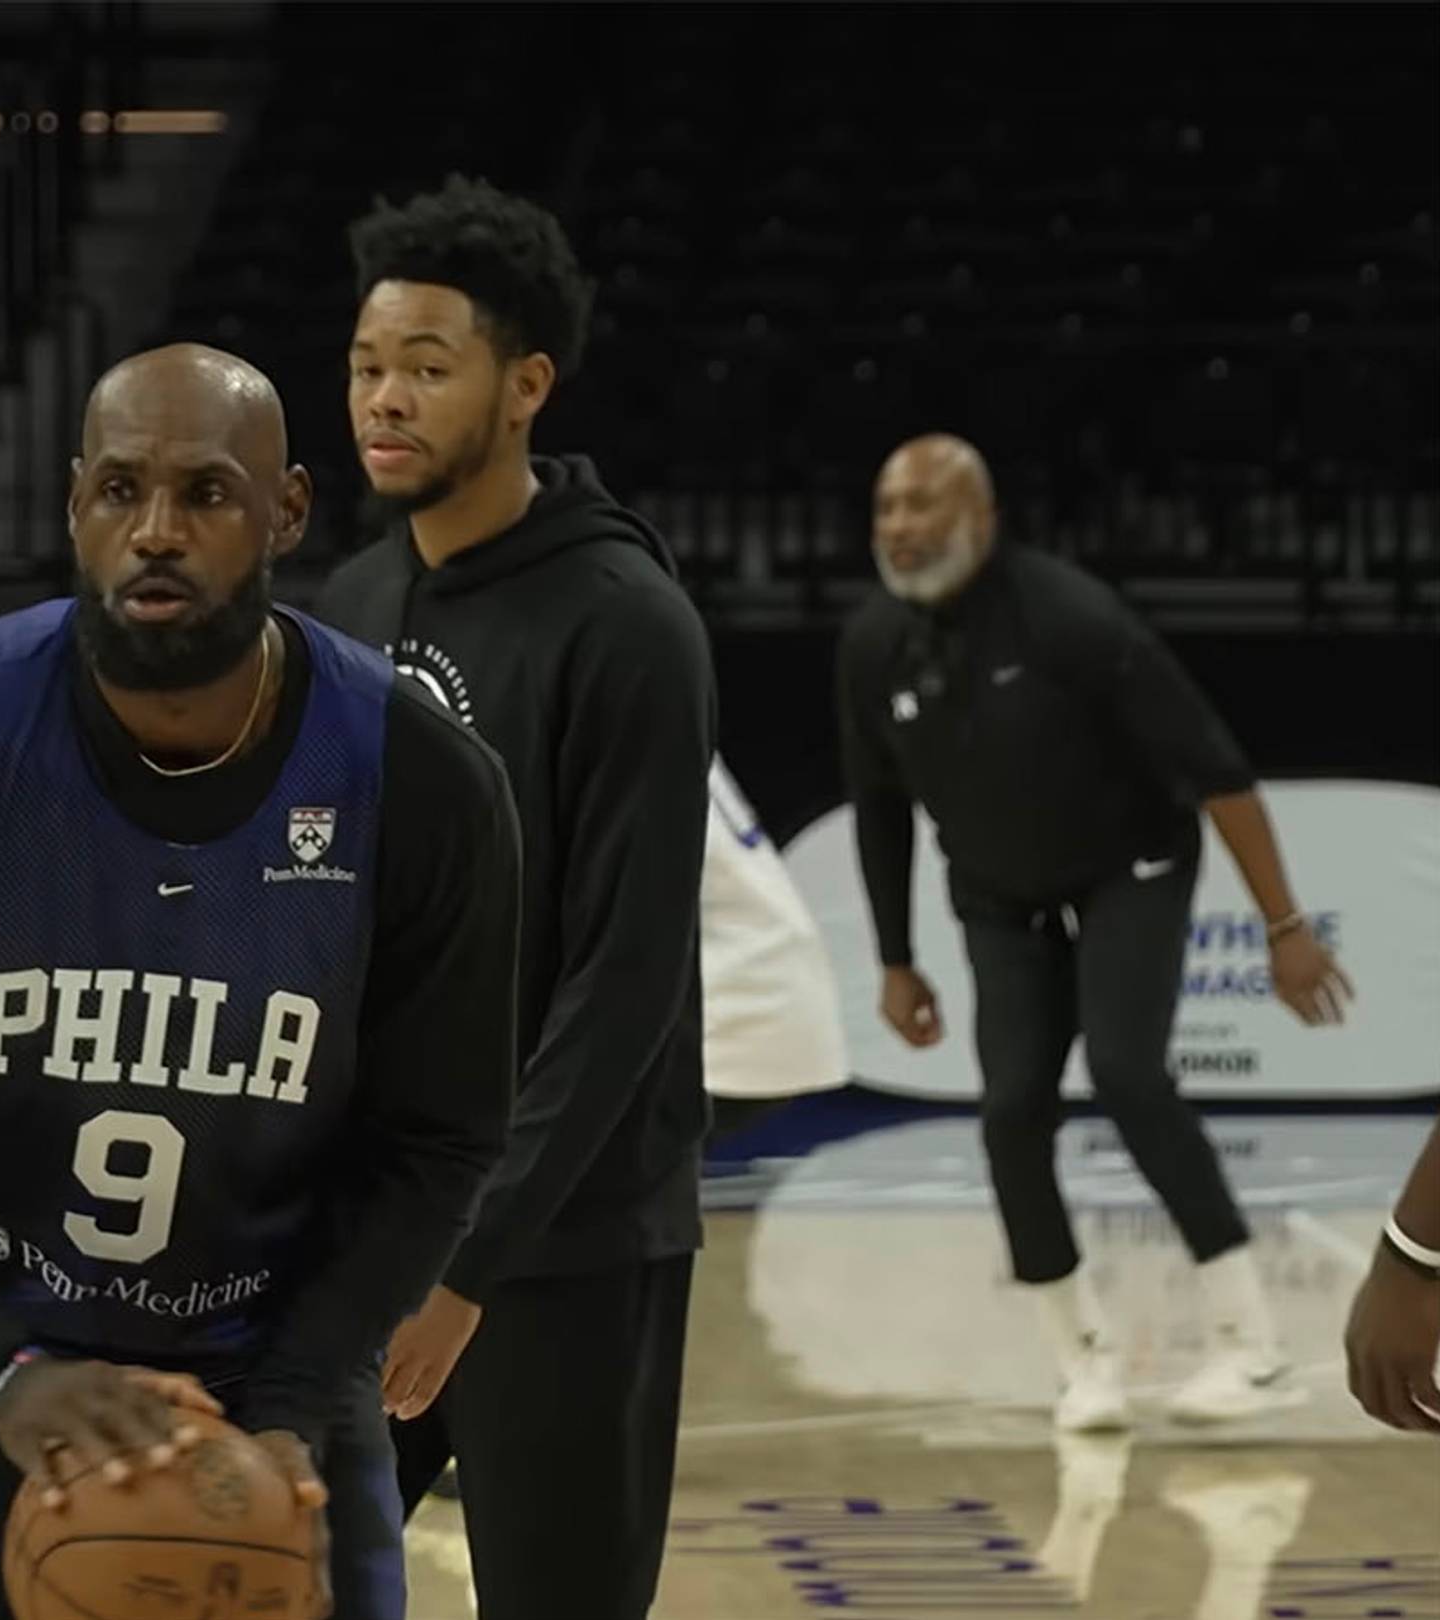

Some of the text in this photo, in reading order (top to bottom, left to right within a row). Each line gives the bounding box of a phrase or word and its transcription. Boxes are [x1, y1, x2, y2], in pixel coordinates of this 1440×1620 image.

[293, 864, 356, 884] Medicine
[64, 1110, 186, 1263] 9
[105, 1268, 271, 1317] Medicine
